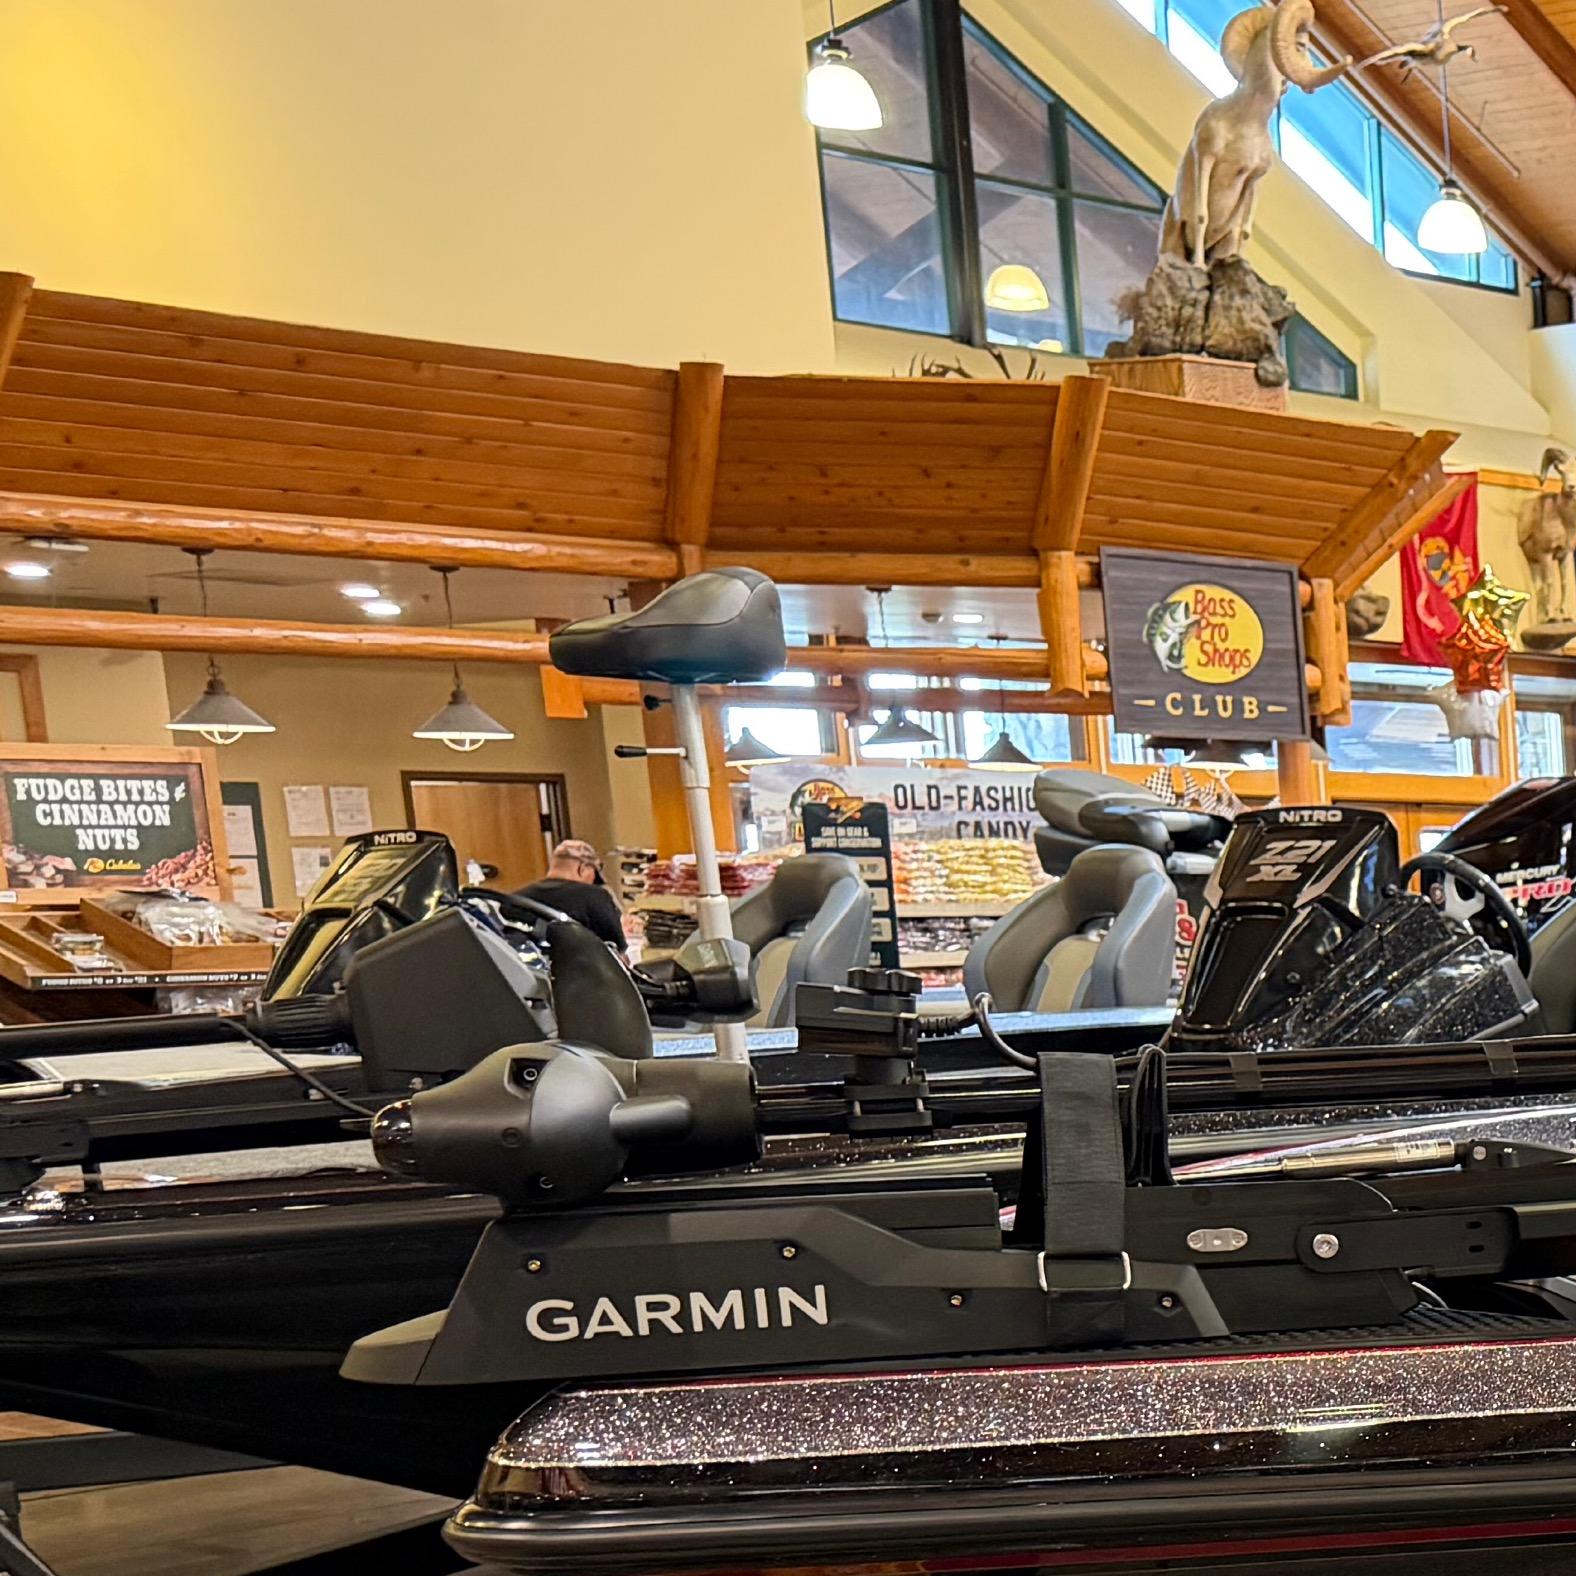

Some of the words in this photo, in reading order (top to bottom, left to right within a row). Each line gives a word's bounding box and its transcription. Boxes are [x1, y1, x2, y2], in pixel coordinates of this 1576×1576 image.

[1192, 589, 1237, 618] Bass
[1195, 617, 1229, 643] Pro
[1197, 640, 1251, 675] Shops
[1165, 692, 1260, 719] CLUB
[13, 777, 95, 801] FUDGE
[100, 779, 169, 802] BITES
[35, 803, 171, 826] CINNAMON
[1279, 810, 1343, 823] NITRO
[76, 828, 140, 851] NUTS
[374, 831, 417, 846] NITRO
[1496, 864, 1561, 884] MERCURY
[525, 1284, 829, 1342] GARMIN
